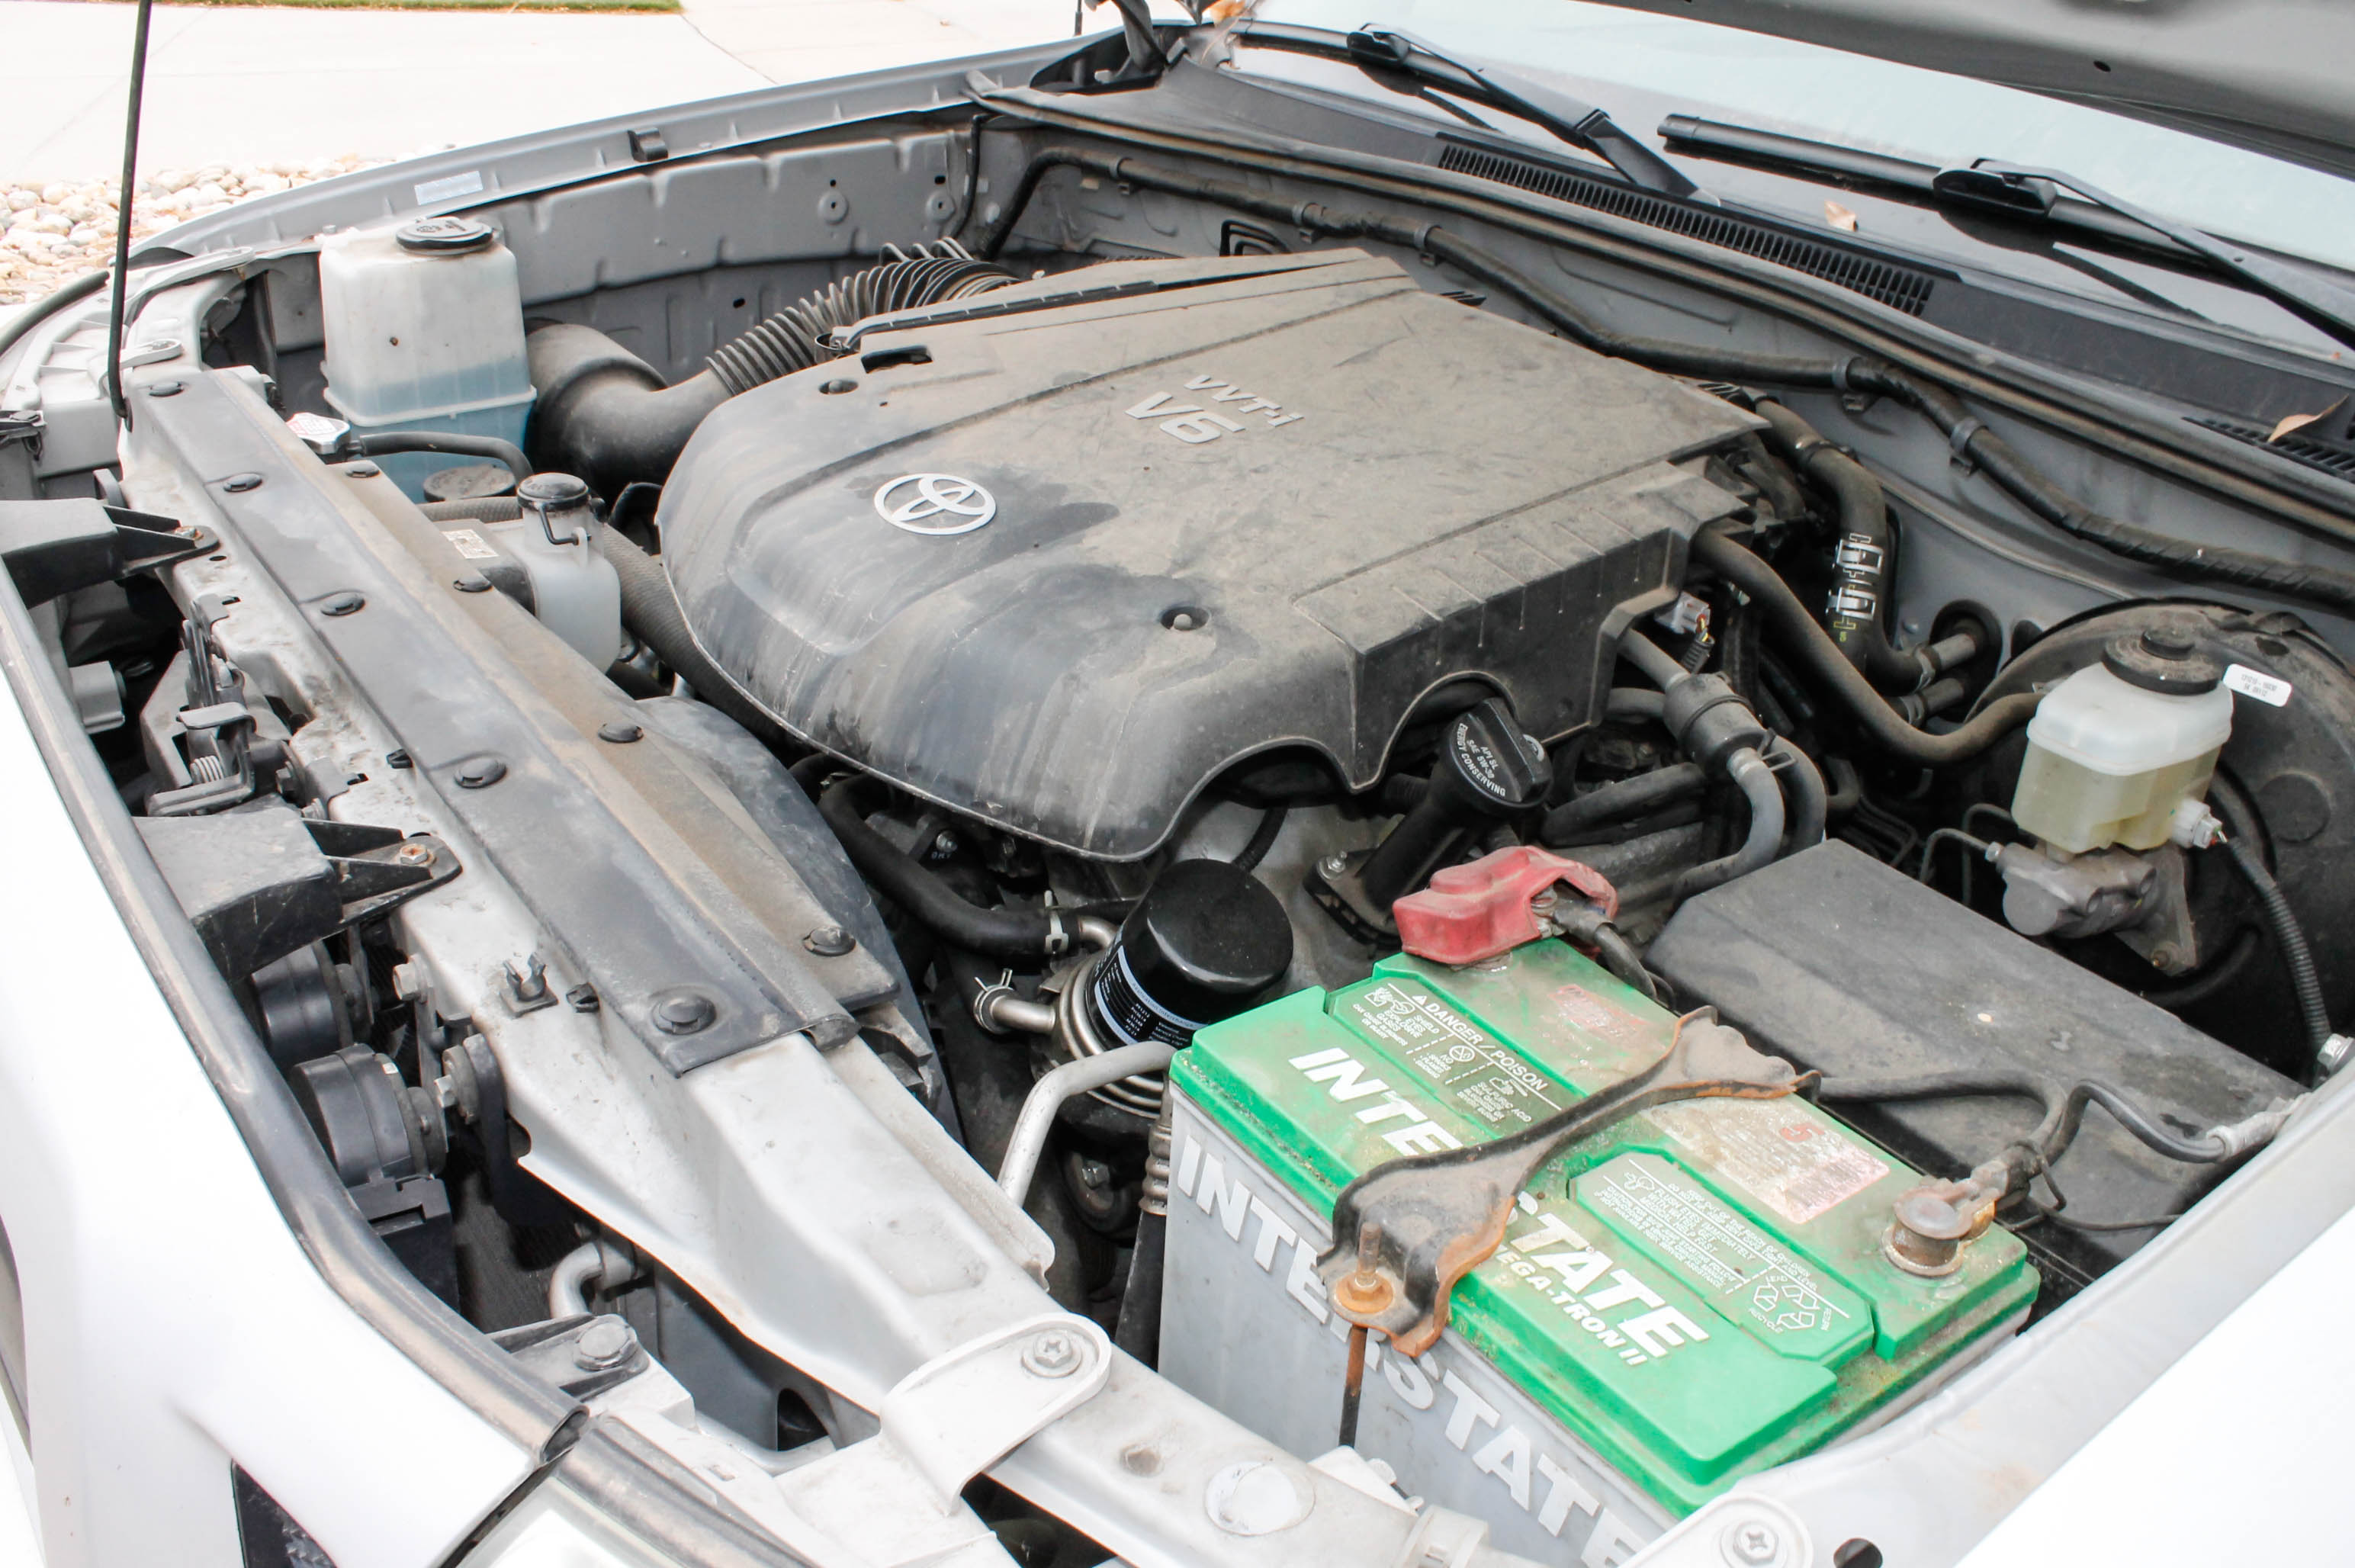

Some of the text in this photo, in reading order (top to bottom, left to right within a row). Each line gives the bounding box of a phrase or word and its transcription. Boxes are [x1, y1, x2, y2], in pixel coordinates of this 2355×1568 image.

[1124, 391, 1245, 444] V6
[1184, 374, 1304, 427] VVT-i
[1457, 723, 1506, 797] ENERGY CONSERVING
[1467, 739, 1495, 779] SAE 5W-30
[1480, 746, 1499, 770] API SL
[1425, 1002, 1483, 1046] DANGER
[1491, 1049, 1548, 1091] POISON
[1618, 1348, 1648, 1366] II
